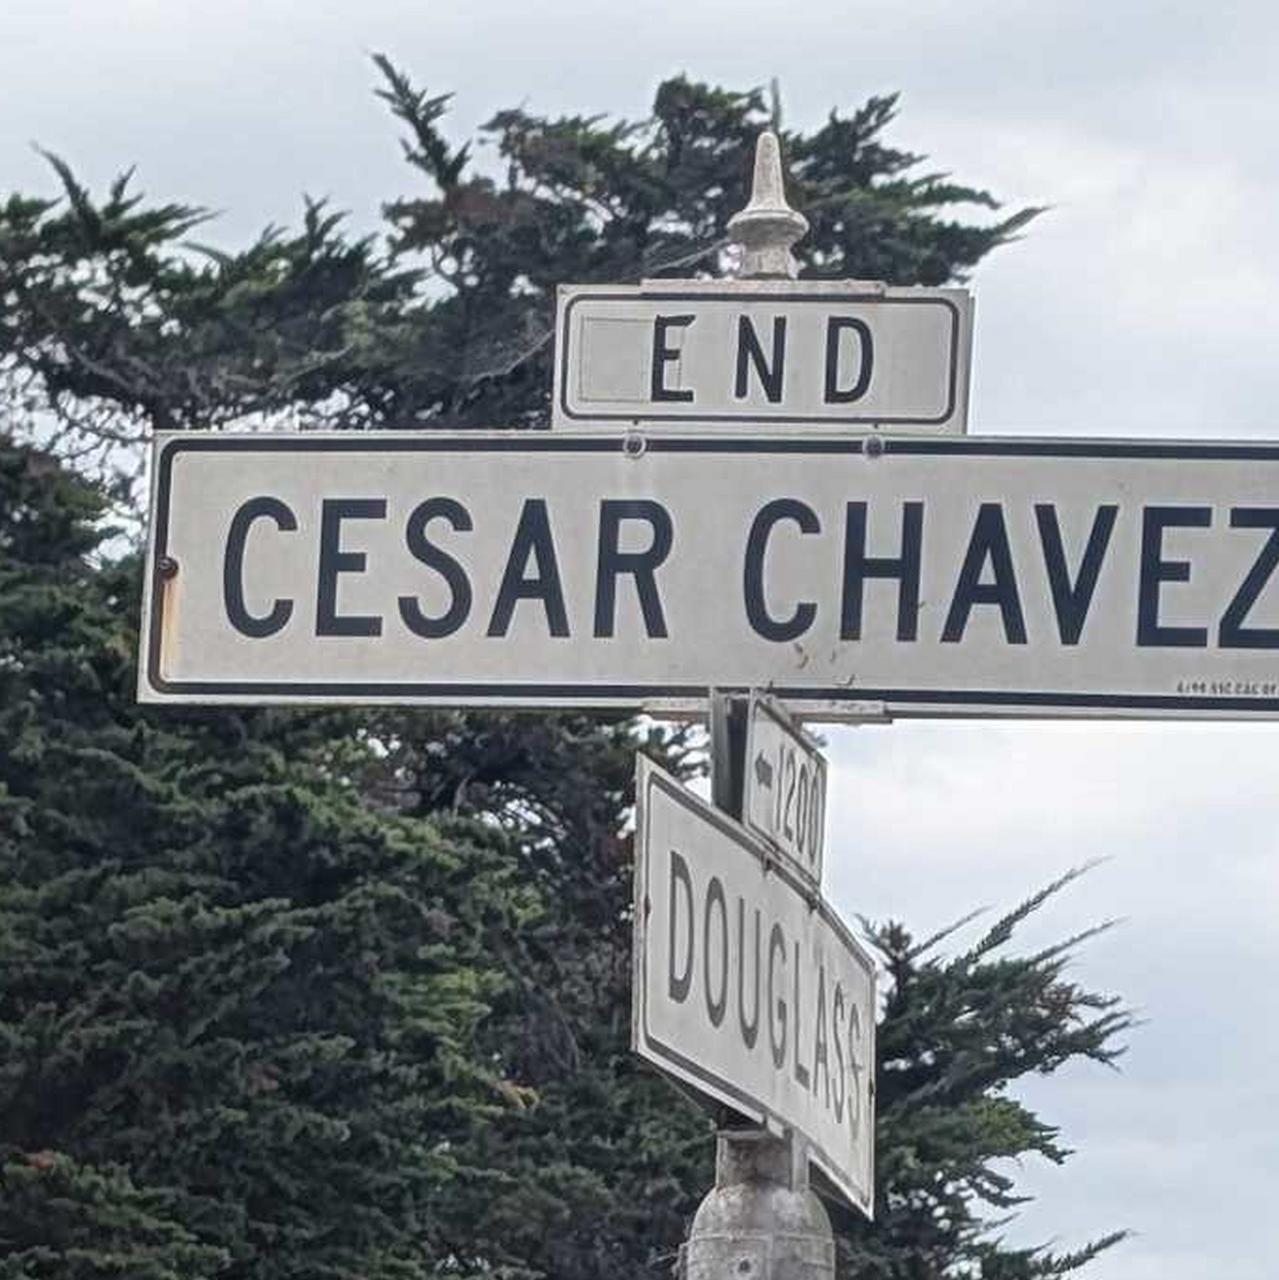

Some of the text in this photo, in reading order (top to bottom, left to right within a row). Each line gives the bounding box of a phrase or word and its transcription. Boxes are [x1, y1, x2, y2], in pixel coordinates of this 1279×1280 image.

[650, 314, 874, 404] END
[223, 494, 675, 640] CESAR
[775, 745, 820, 866] 1200
[668, 849, 863, 1138] DOUGLASS
